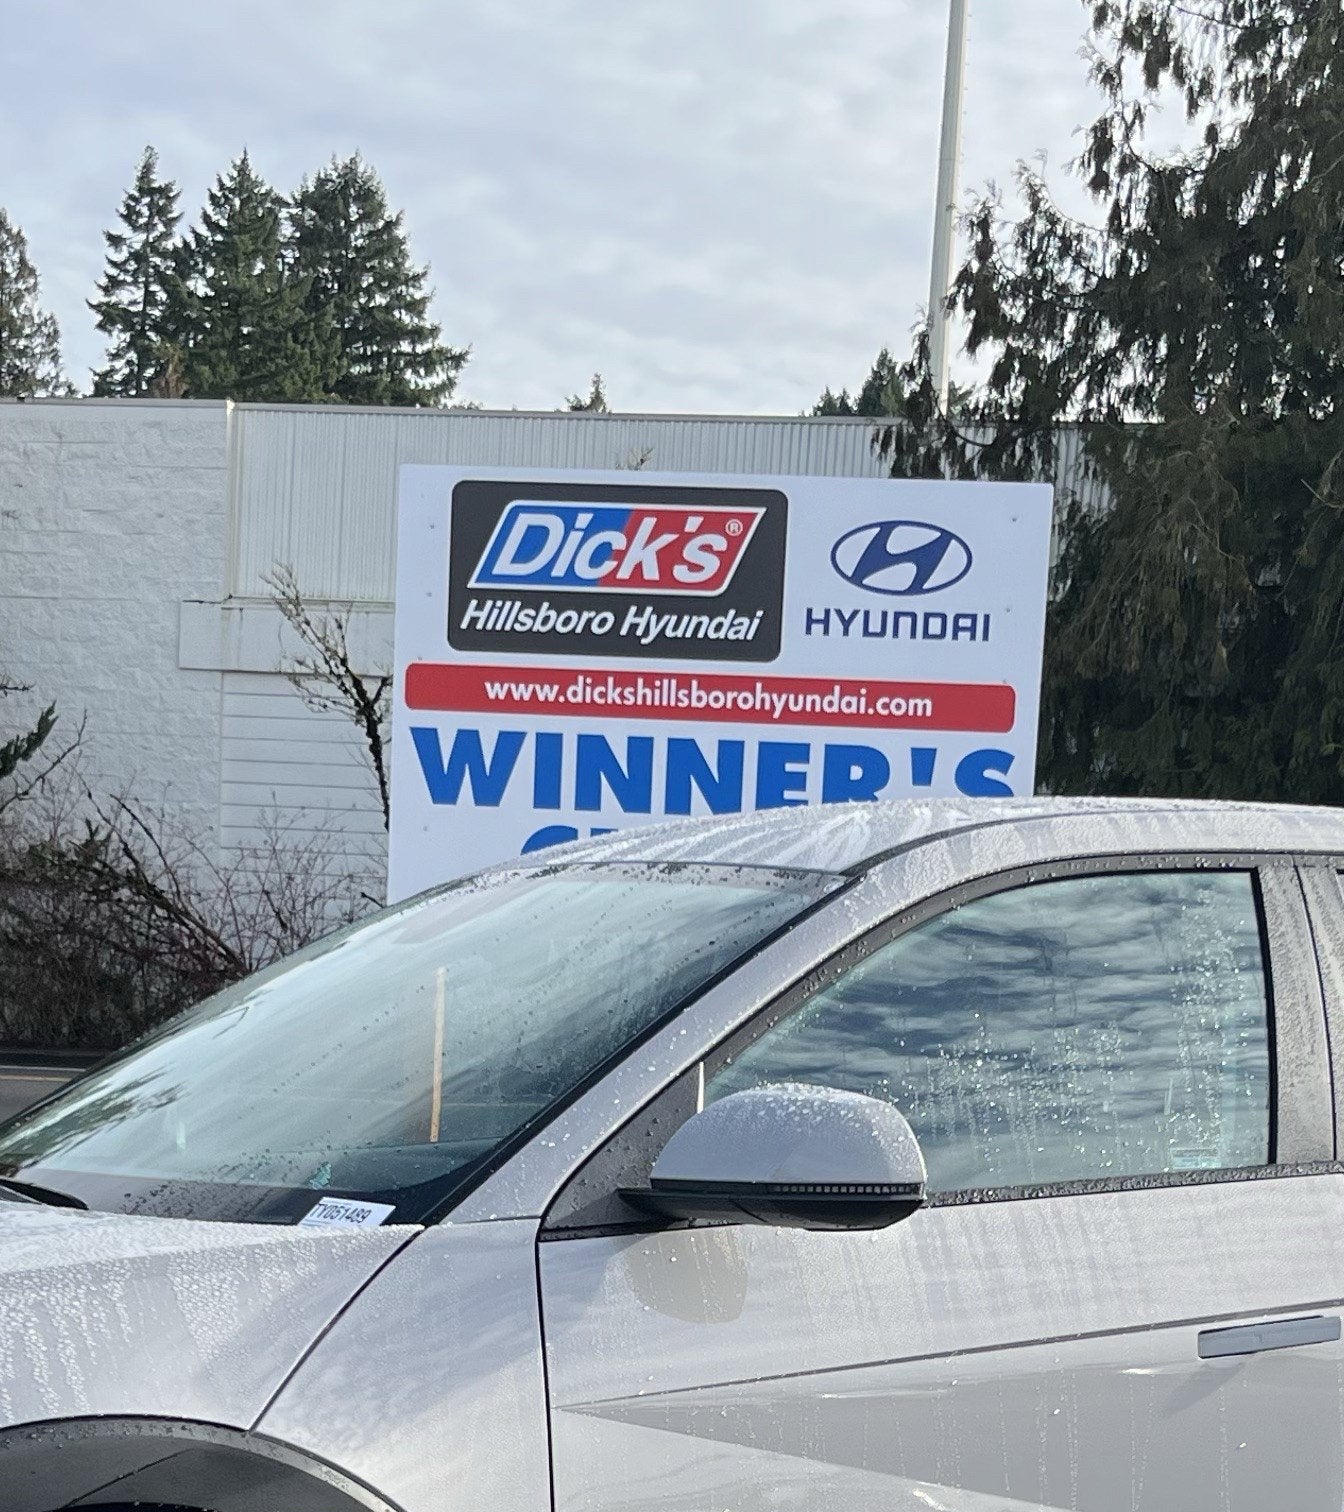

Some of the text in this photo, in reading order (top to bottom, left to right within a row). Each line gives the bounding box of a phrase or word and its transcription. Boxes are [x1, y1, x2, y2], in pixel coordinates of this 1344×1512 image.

[460, 599, 763, 645] Hillsboro Hyundai
[805, 607, 991, 642] HYUNDAI
[484, 676, 933, 719] www.dickshillsborohyundai.com
